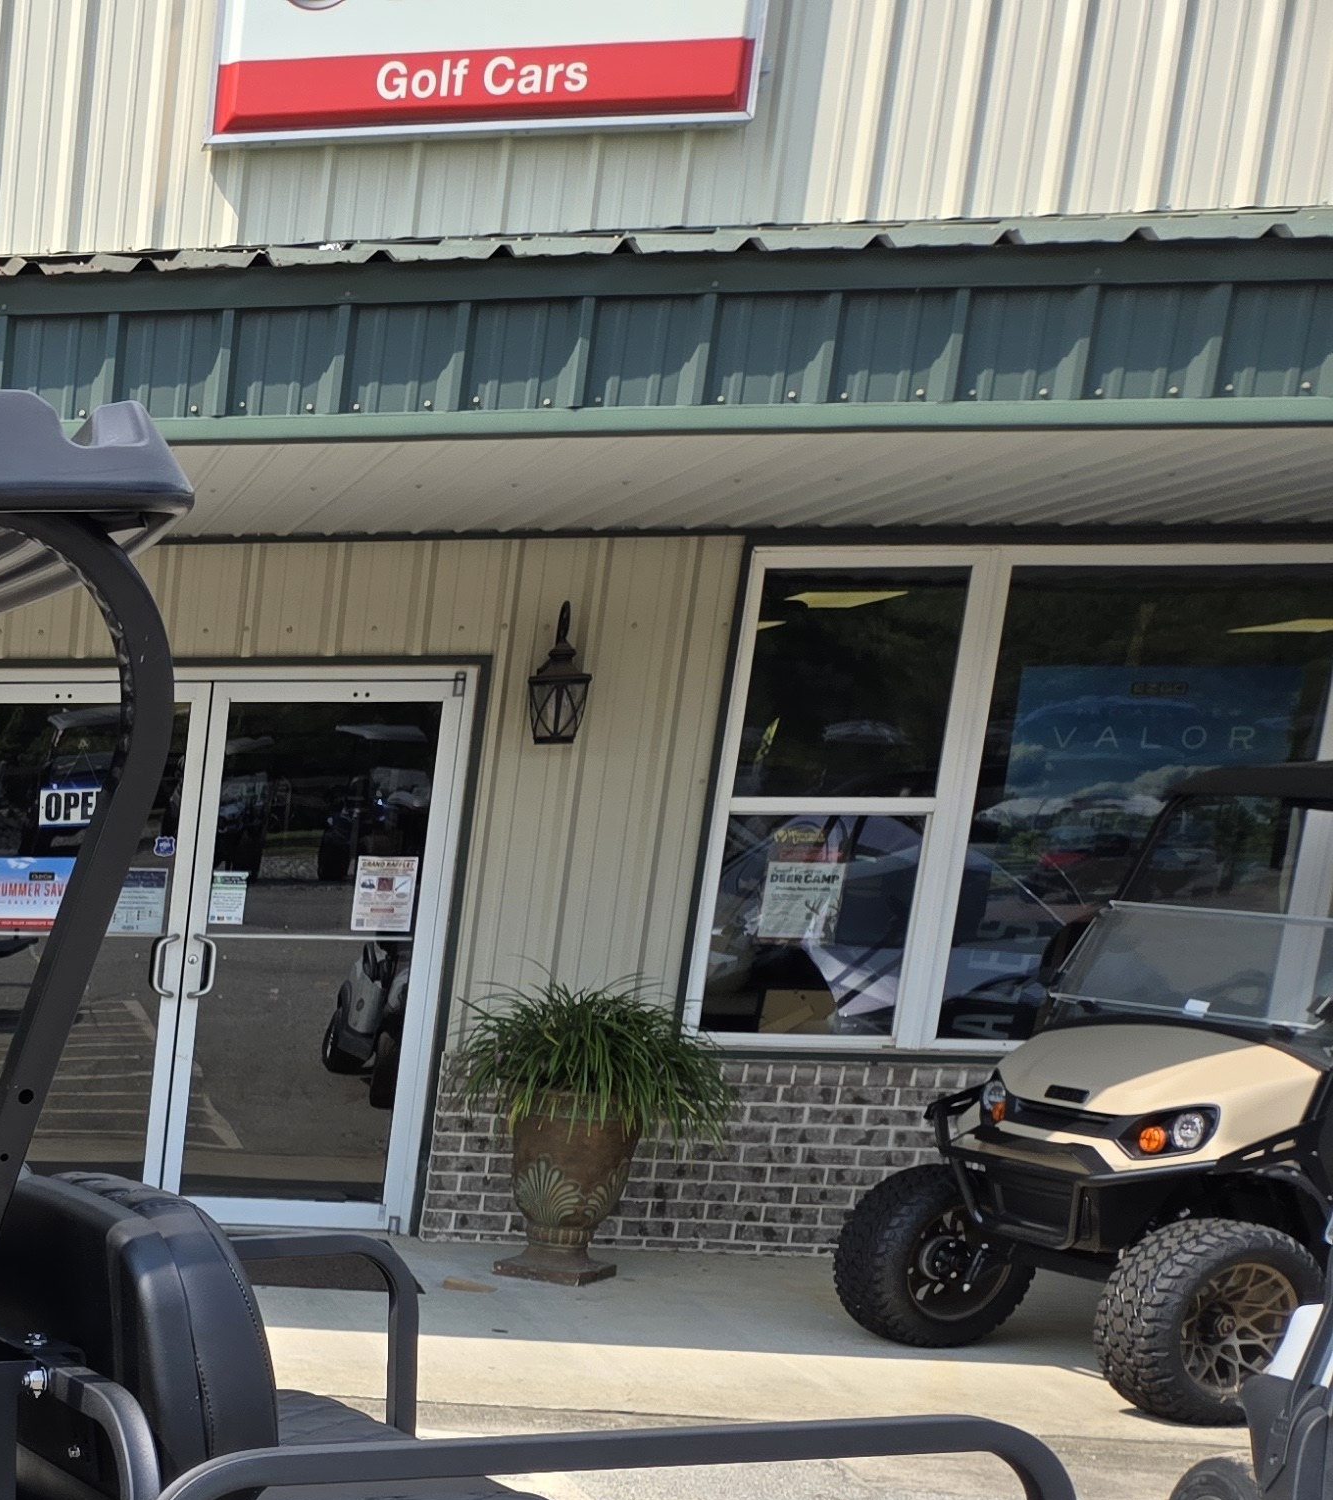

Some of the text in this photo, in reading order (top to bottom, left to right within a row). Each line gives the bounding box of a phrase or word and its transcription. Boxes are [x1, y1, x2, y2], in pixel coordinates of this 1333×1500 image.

[376, 55, 589, 100] Golf Cars
[1053, 725, 1256, 750] VALOR
[44, 791, 94, 821] OPE
[770, 874, 840, 884] DEER CAMP
